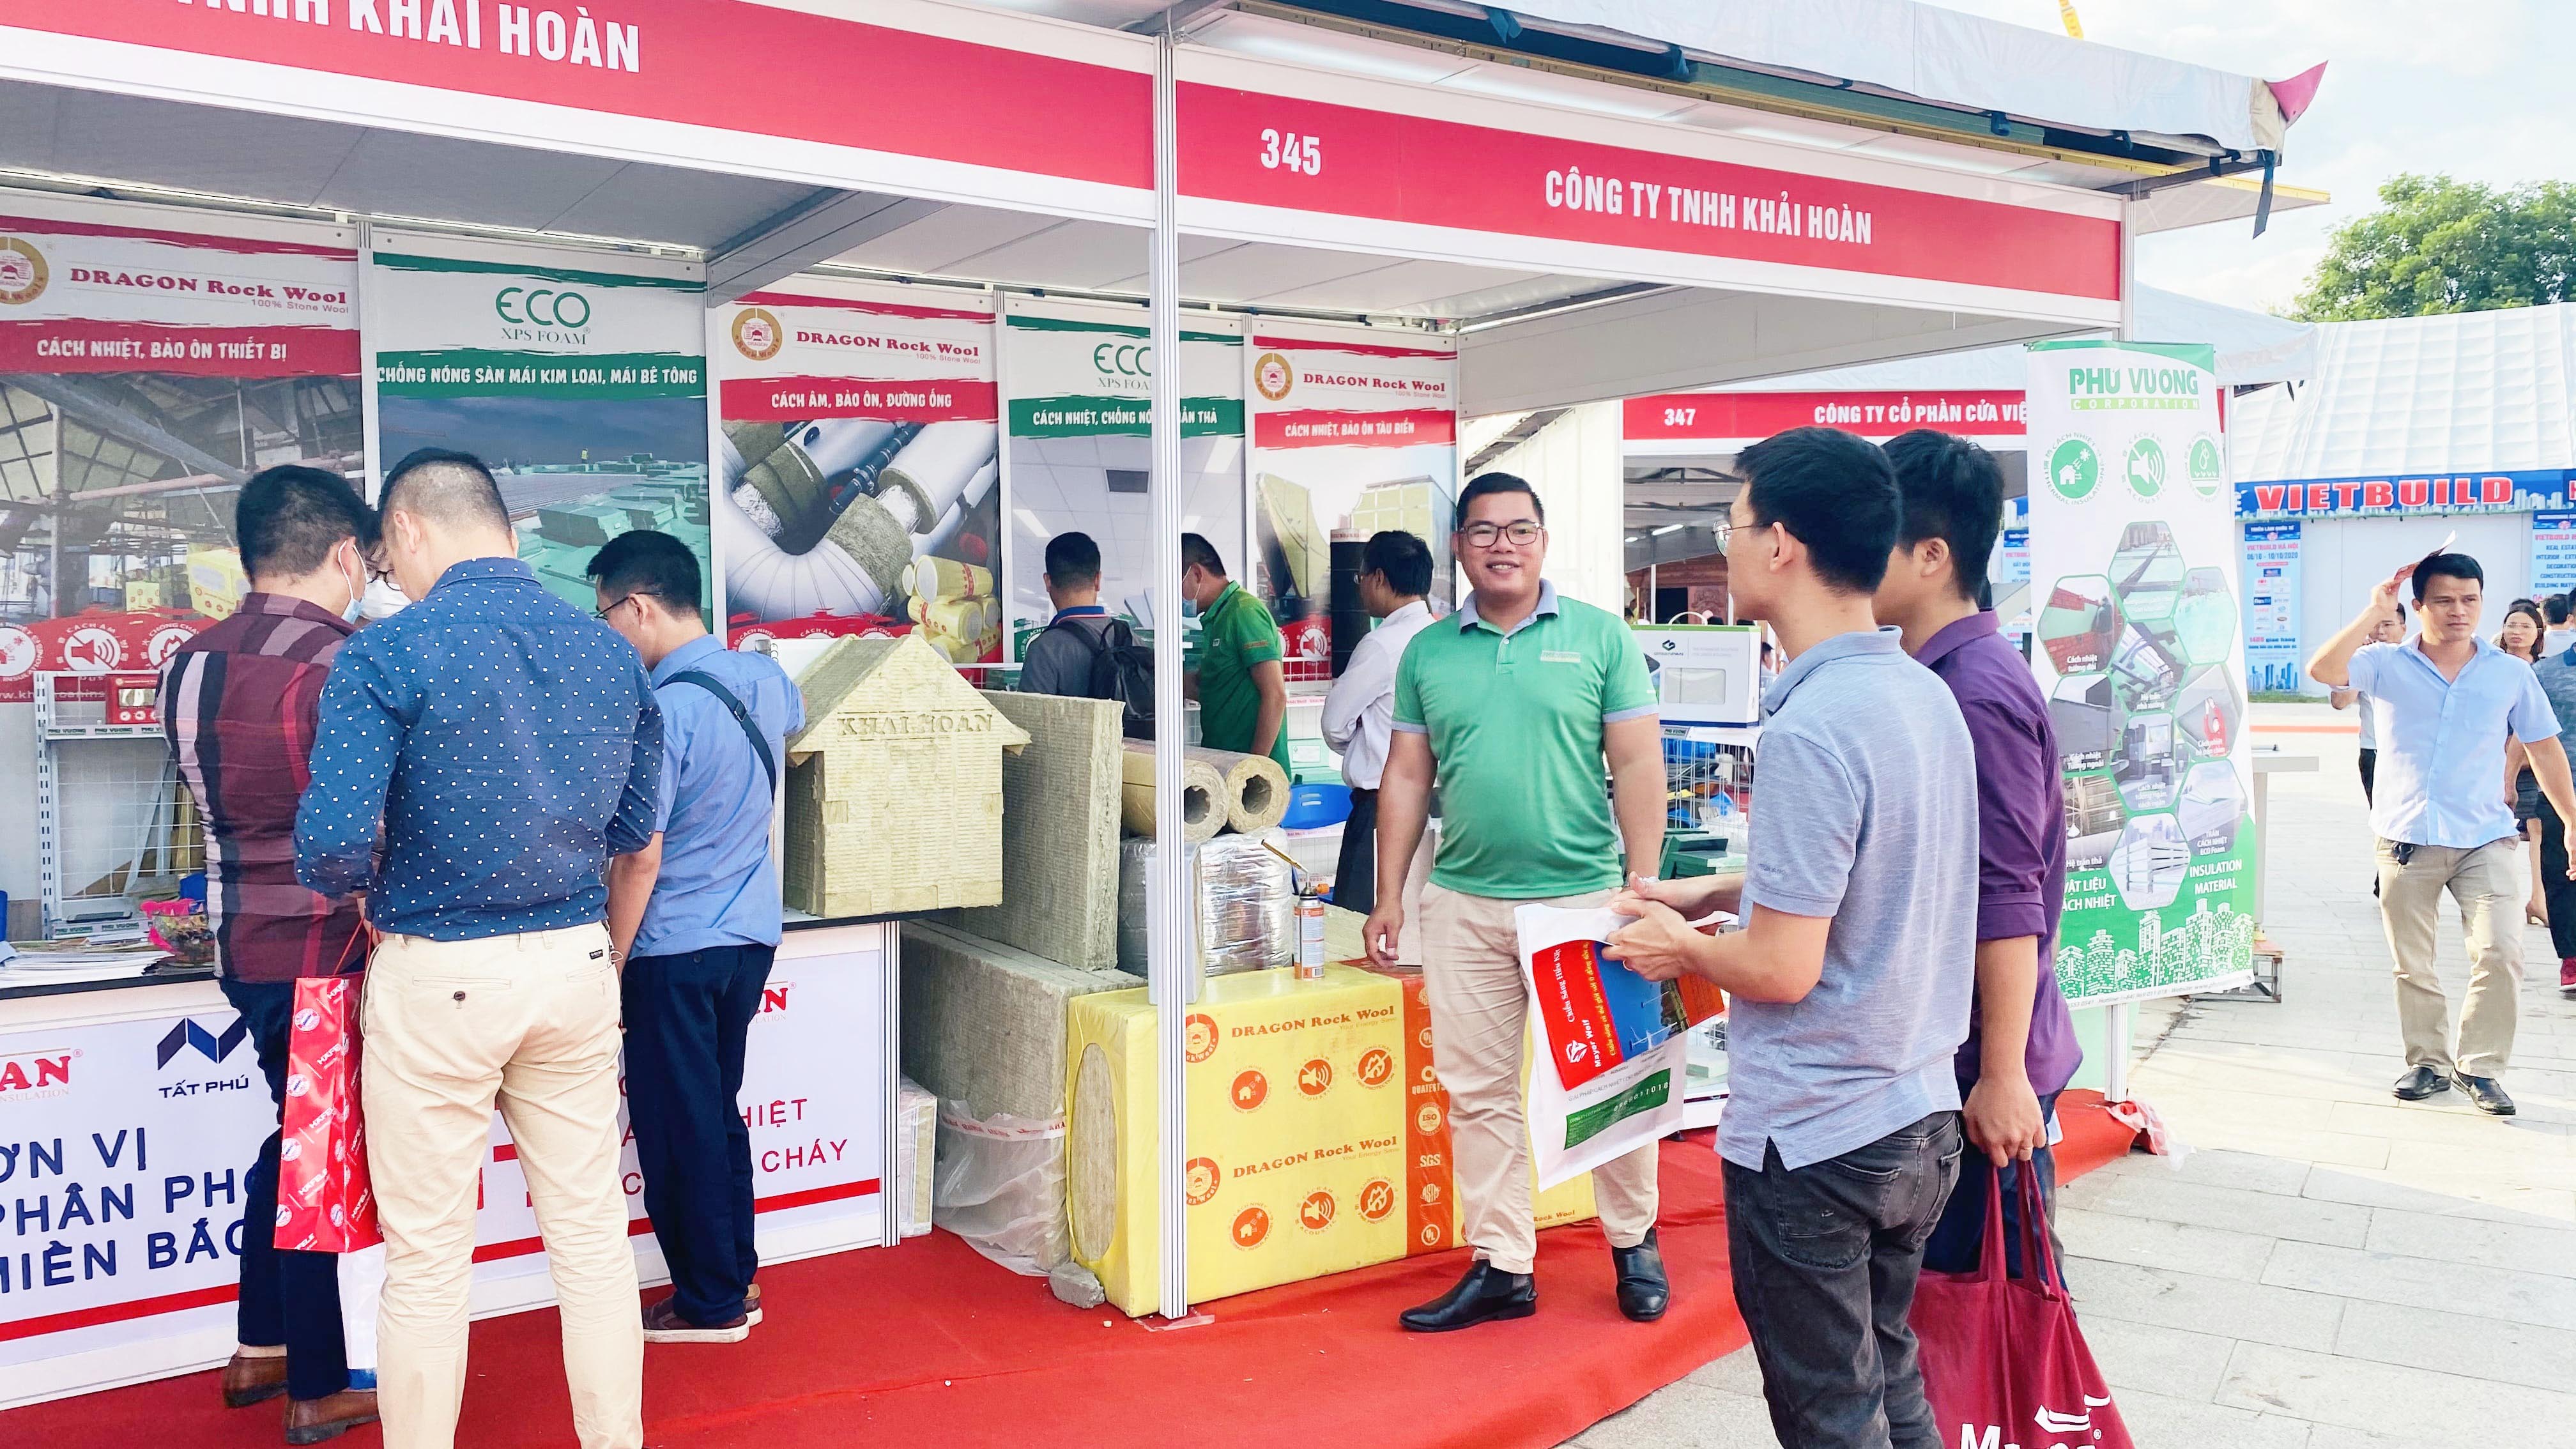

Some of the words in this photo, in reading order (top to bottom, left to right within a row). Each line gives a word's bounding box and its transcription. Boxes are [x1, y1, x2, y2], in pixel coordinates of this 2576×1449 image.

[497, 3, 640, 73] HOÀN
[1259, 128, 1322, 176] 345
[1544, 165, 1623, 216] CÔNG
[1630, 178, 1659, 220] TY
[1667, 183, 1735, 228] TNHH
[1743, 190, 1801, 236] KHẢI
[1808, 203, 1871, 245] HOÀN
[70, 268, 197, 291] DRAGON
[207, 280, 275, 298] Rock
[282, 286, 347, 303] Wool
[251, 299, 282, 308] 100%
[287, 302, 319, 311] Stone
[322, 304, 349, 314] Wool
[495, 286, 591, 328] ECO
[501, 327, 532, 341] XPS
[537, 330, 587, 345] FOAM
[797, 331, 880, 348] DRAGON
[886, 338, 931, 353] Rock
[936, 343, 979, 356] Wool
[36, 336, 86, 357] CÁCH
[90, 337, 146, 360] NHIỆT,
[190, 338, 213, 359] ÔN
[218, 335, 266, 360] THIẾT
[270, 343, 287, 362] BỊ
[916, 353, 937, 361] 100%
[963, 356, 981, 365] Wool
[376, 360, 426, 383] CHỐNG
[431, 364, 471, 383] NÓNG
[475, 364, 505, 384] SÀN
[509, 365, 537, 383] MÁI
[540, 368, 567, 384] KIM
[572, 368, 606, 387] LOẠI,
[610, 365, 636, 384] MÁI
[640, 365, 658, 384] BÊ
[662, 365, 697, 384] TÔNG
[1098, 377, 1121, 388] XPS
[1124, 379, 1151, 390] FOA
[1303, 373, 1368, 387] DRAGON
[1373, 378, 1407, 390] Rock
[1412, 380, 1446, 392] Wool
[771, 390, 805, 409] CÁCH
[809, 389, 832, 409] ÂM,
[863, 390, 883, 409] ÔN,
[886, 389, 926, 408] ĐƯỜNG
[929, 388, 952, 408] ỐNG
[1814, 402, 1862, 424] CÔNG
[1865, 406, 1884, 423] TY
[1889, 395, 1912, 424] CỔ
[1915, 397, 1961, 423] PHẦN
[1965, 398, 1999, 423] CỬA
[2002, 401, 2027, 425] VIỆ
[2073, 399, 2198, 410] CORPORATION
[1032, 409, 1062, 425] CÁCH
[1285, 422, 1309, 437] CÁCH
[1376, 420, 1392, 435] TÀU
[1664, 408, 1696, 426] 347
[2254, 476, 2514, 510] VIETBUILD
[2189, 859, 2242, 878] INSULATION
[2195, 878, 2238, 894] MATERIAL
[1231, 1018, 1305, 1038] DRAGON
[1311, 1013, 1351, 1027] Rock
[1356, 1006, 1395, 1020] Wool
[158, 1079, 200, 1099] TẤT
[205, 1074, 249, 1094] PHÚ
[740, 1098, 808, 1129] HIỆT
[1422, 1114, 1438, 1122] ISO
[92, 1126, 148, 1172] VỊ
[762, 1137, 848, 1174] CHÁY
[1233, 1152, 1308, 1178] DRAGON
[1314, 1144, 1354, 1160] Rock
[1358, 1135, 1397, 1151] Wool
[1419, 1153, 1441, 1168] SGS
[1556, 1209, 1575, 1218] Wool
[1425, 1228, 1436, 1242] UL
